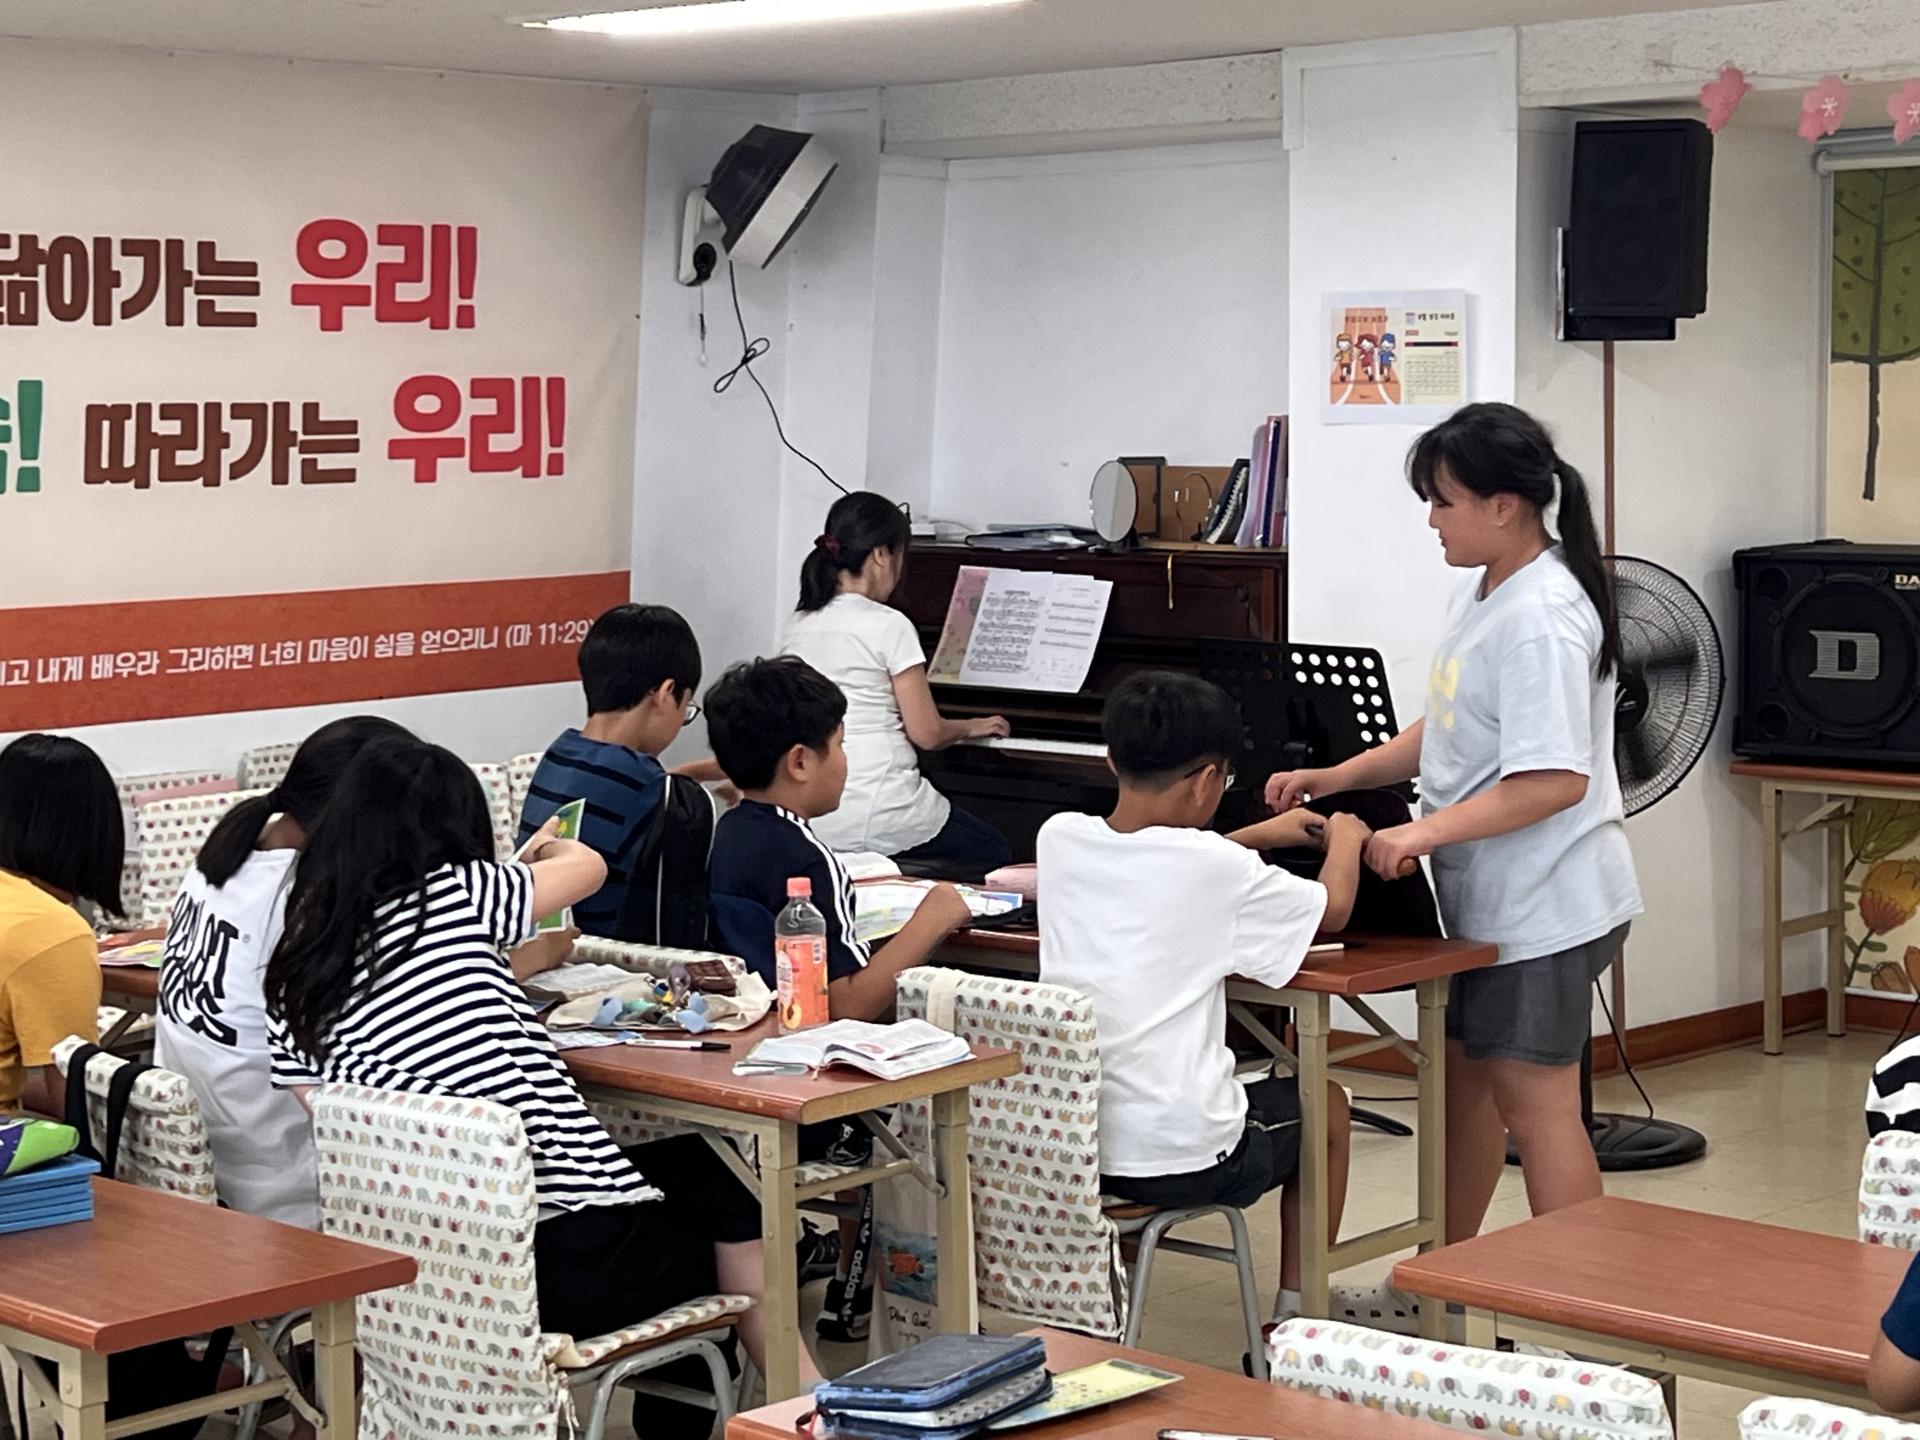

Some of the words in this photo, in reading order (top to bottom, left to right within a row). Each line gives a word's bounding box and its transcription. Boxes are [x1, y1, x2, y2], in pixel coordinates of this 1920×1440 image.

[0, 233, 260, 328] 닮아가는
[291, 218, 478, 332] 우리!
[84, 401, 360, 489] 따라가는
[388, 375, 566, 484] 우리!
[0, 659, 30, 686] 고
[36, 656, 84, 684] 내게
[91, 652, 160, 680] 배우라
[166, 645, 254, 675] 그리하면
[260, 640, 302, 667] 너희
[308, 634, 370, 664] 마음이
[374, 630, 415, 658] 쉼을
[420, 627, 499, 656] 얻으리니
[505, 624, 532, 648] (마
[1808, 630, 1880, 680] D
[844, 1250, 864, 1299] adidas
